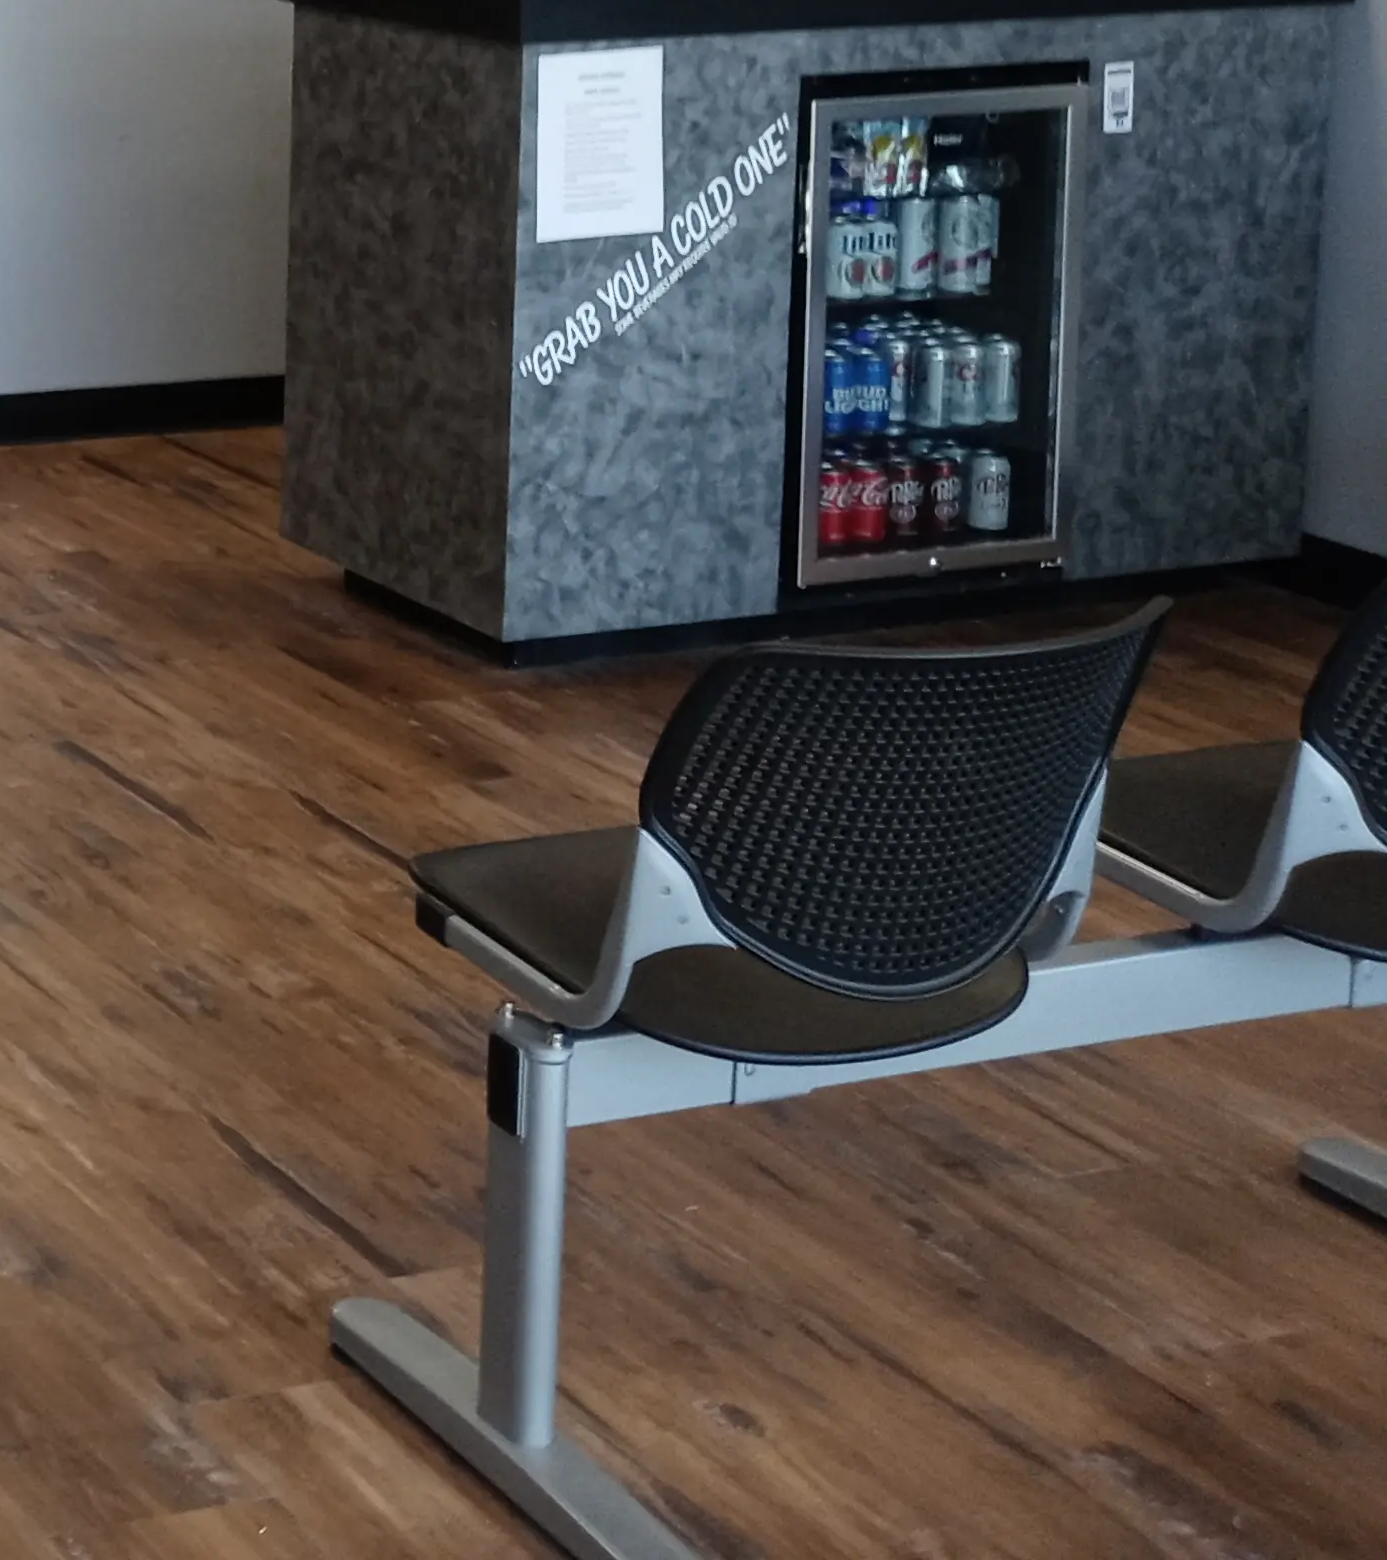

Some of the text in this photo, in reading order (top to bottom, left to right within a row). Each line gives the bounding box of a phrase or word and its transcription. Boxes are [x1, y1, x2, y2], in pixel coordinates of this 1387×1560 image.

[596, 249, 651, 323] YOU
[650, 234, 675, 279] A
[669, 175, 735, 257] COLD
